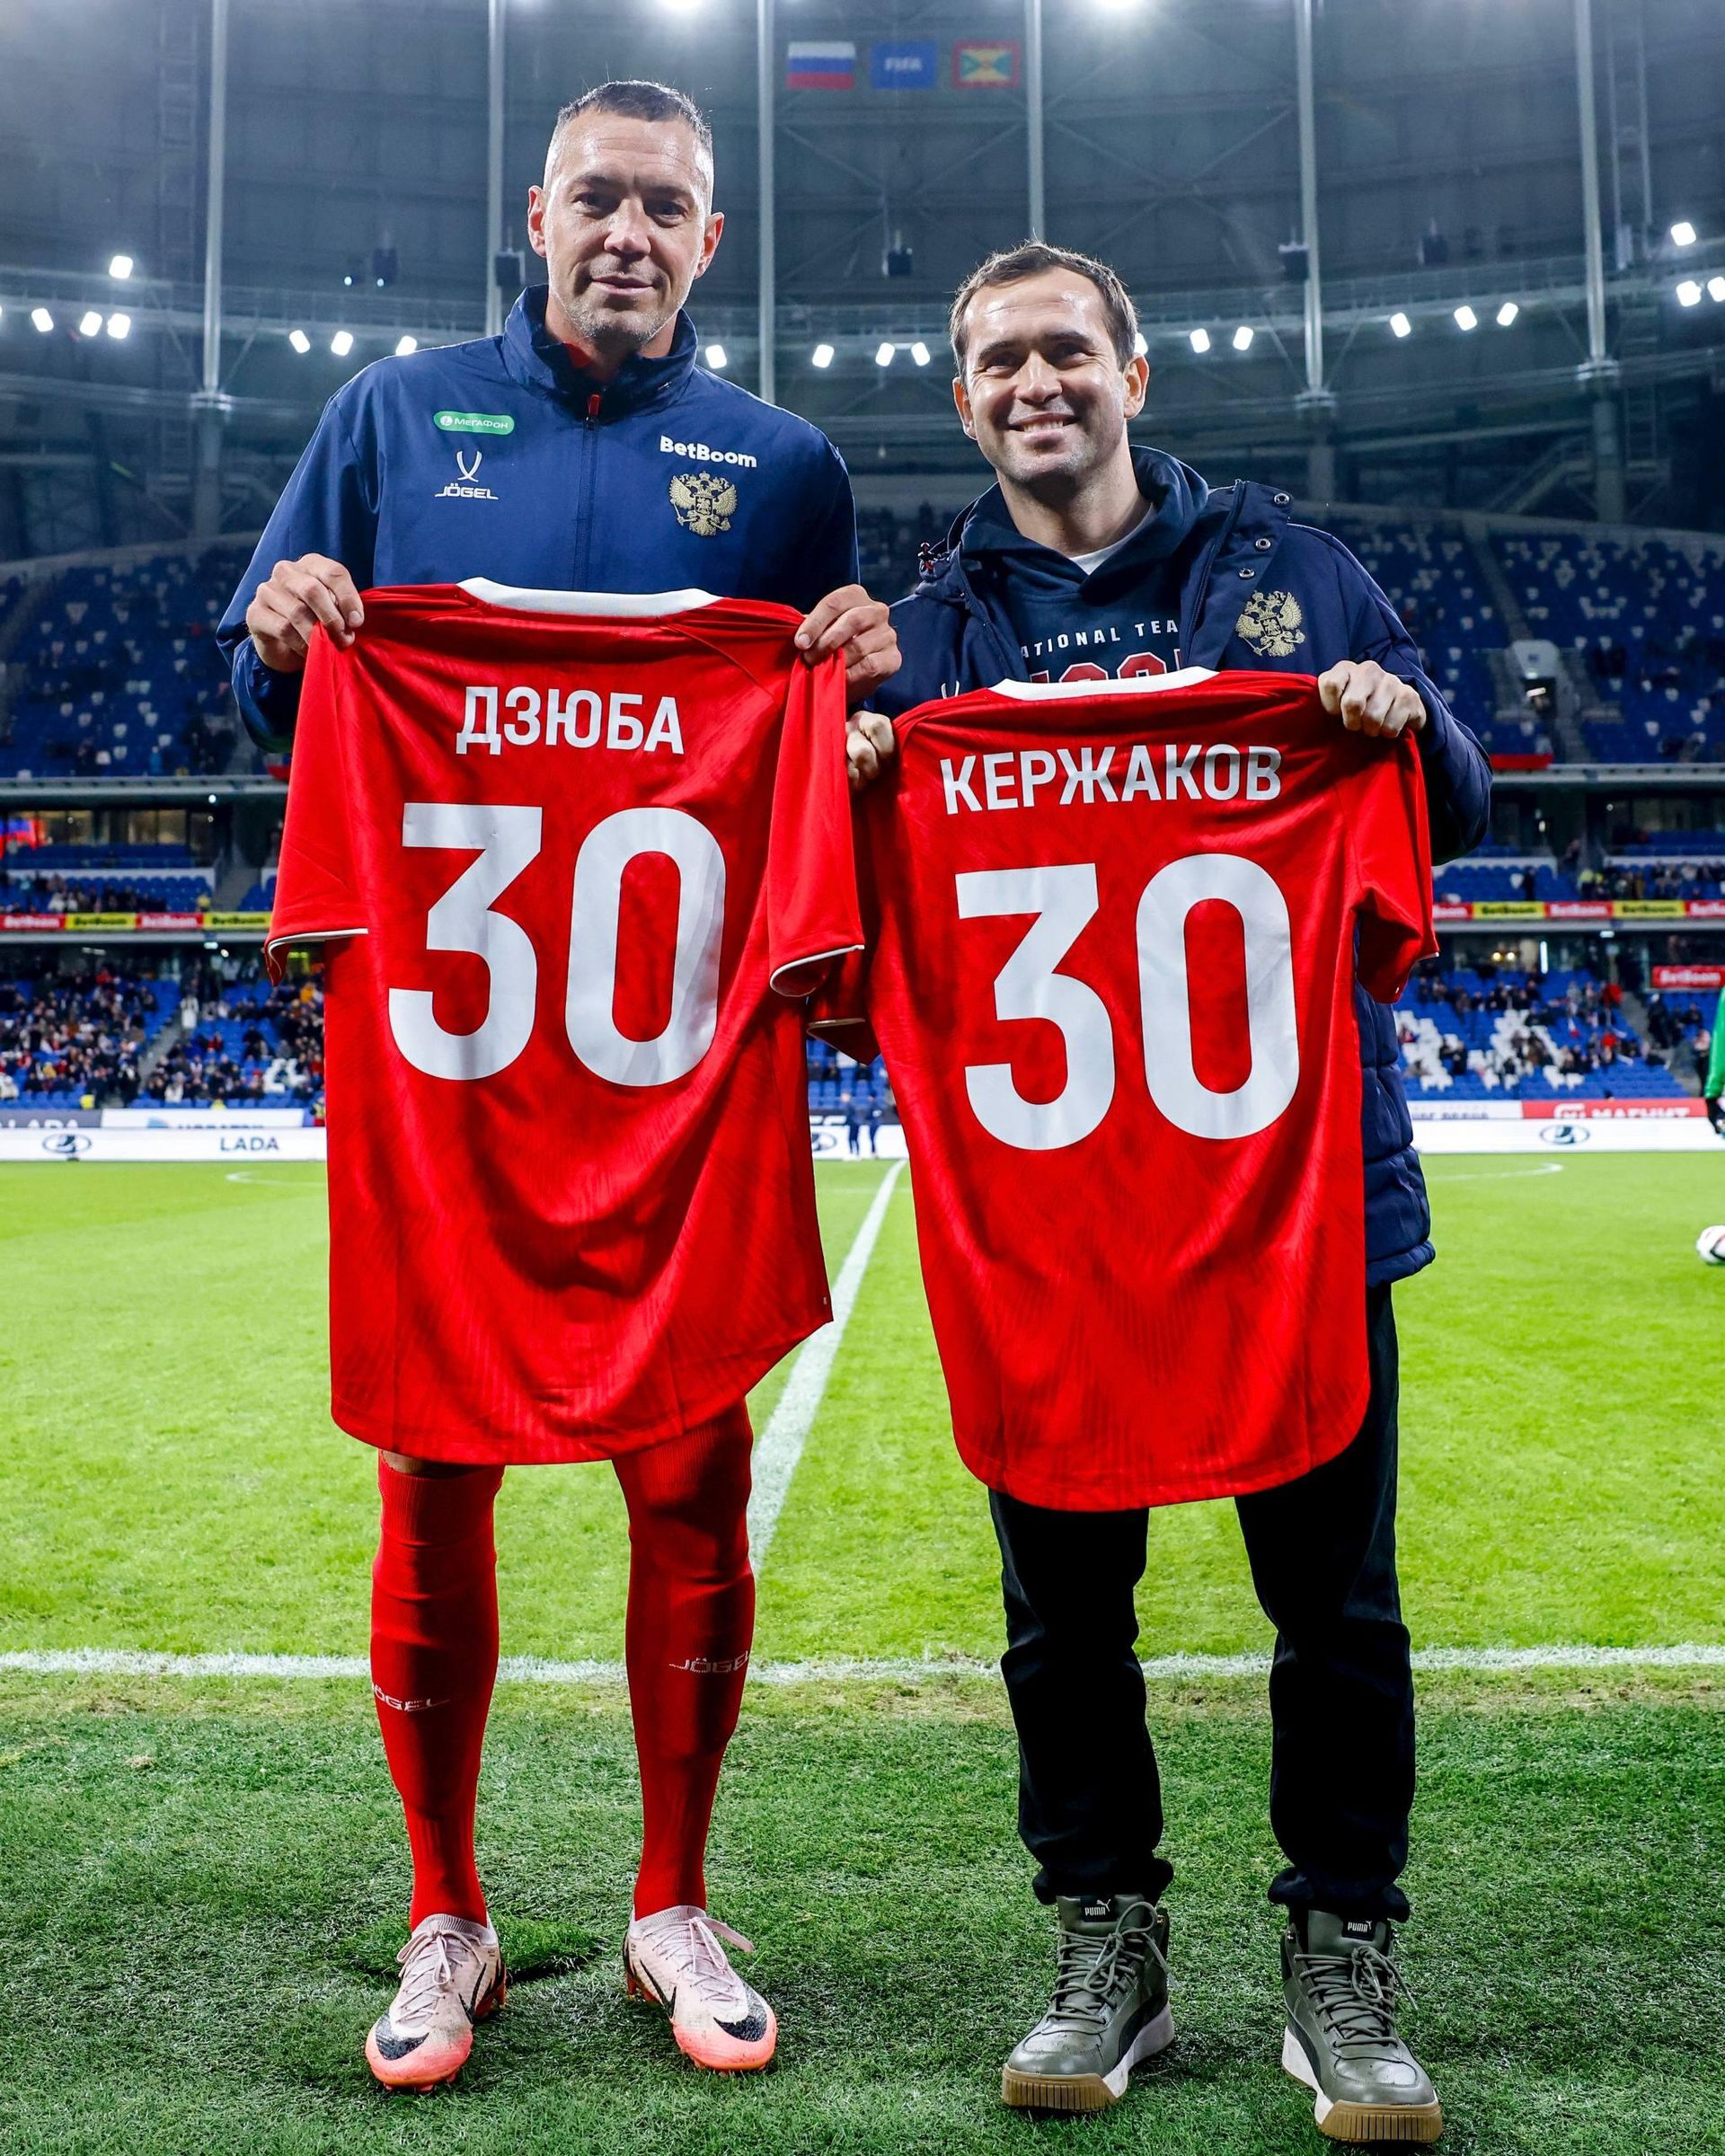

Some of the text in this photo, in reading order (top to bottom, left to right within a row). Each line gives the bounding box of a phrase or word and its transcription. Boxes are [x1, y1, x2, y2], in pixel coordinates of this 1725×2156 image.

[659, 435, 757, 468] BetBoom
[434, 483, 500, 499] JÖGEL
[1021, 620, 1179, 658] ATIONAL TEA
[456, 686, 685, 755] ДЗЮБА
[940, 744, 1283, 815] КЕРЖАКОВ
[388, 802, 726, 1087] 30
[955, 853, 1300, 1151] 30
[219, 1136, 279, 1152] LADA
[372, 1683, 449, 1712] ÖGEL
[1084, 1906, 1106, 1916] PUMA
[1347, 1921, 1368, 1933] PUMA
